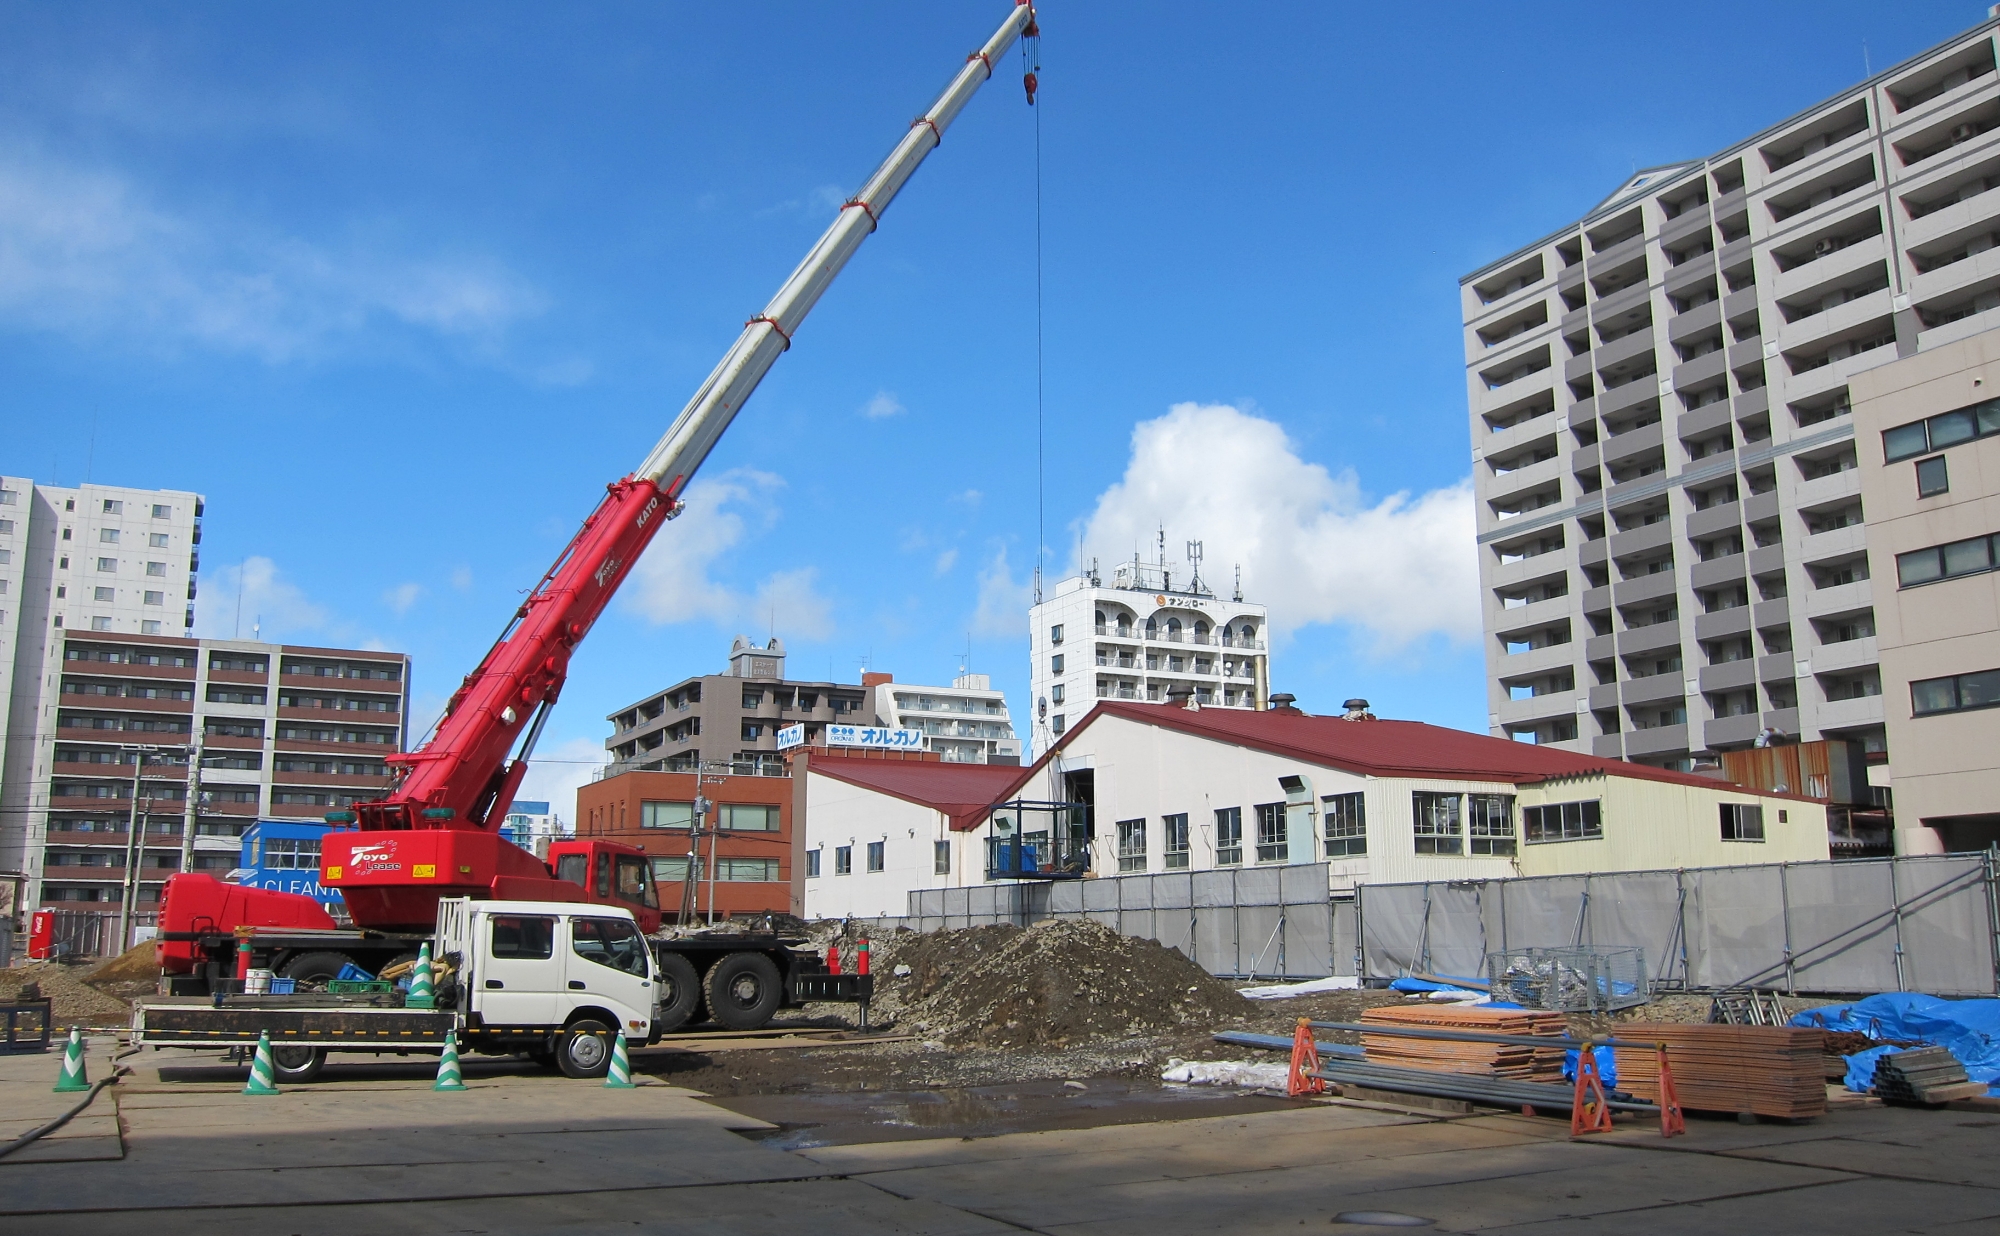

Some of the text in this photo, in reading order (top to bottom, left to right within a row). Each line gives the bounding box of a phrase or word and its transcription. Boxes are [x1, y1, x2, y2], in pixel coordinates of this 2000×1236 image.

[637, 497, 658, 528] KATO
[779, 725, 802, 746] オルガノ
[830, 735, 854, 743] ORGANO
[861, 728, 920, 746] オルガノ
[350, 846, 389, 866] Toyo
[366, 861, 402, 870] Lease
